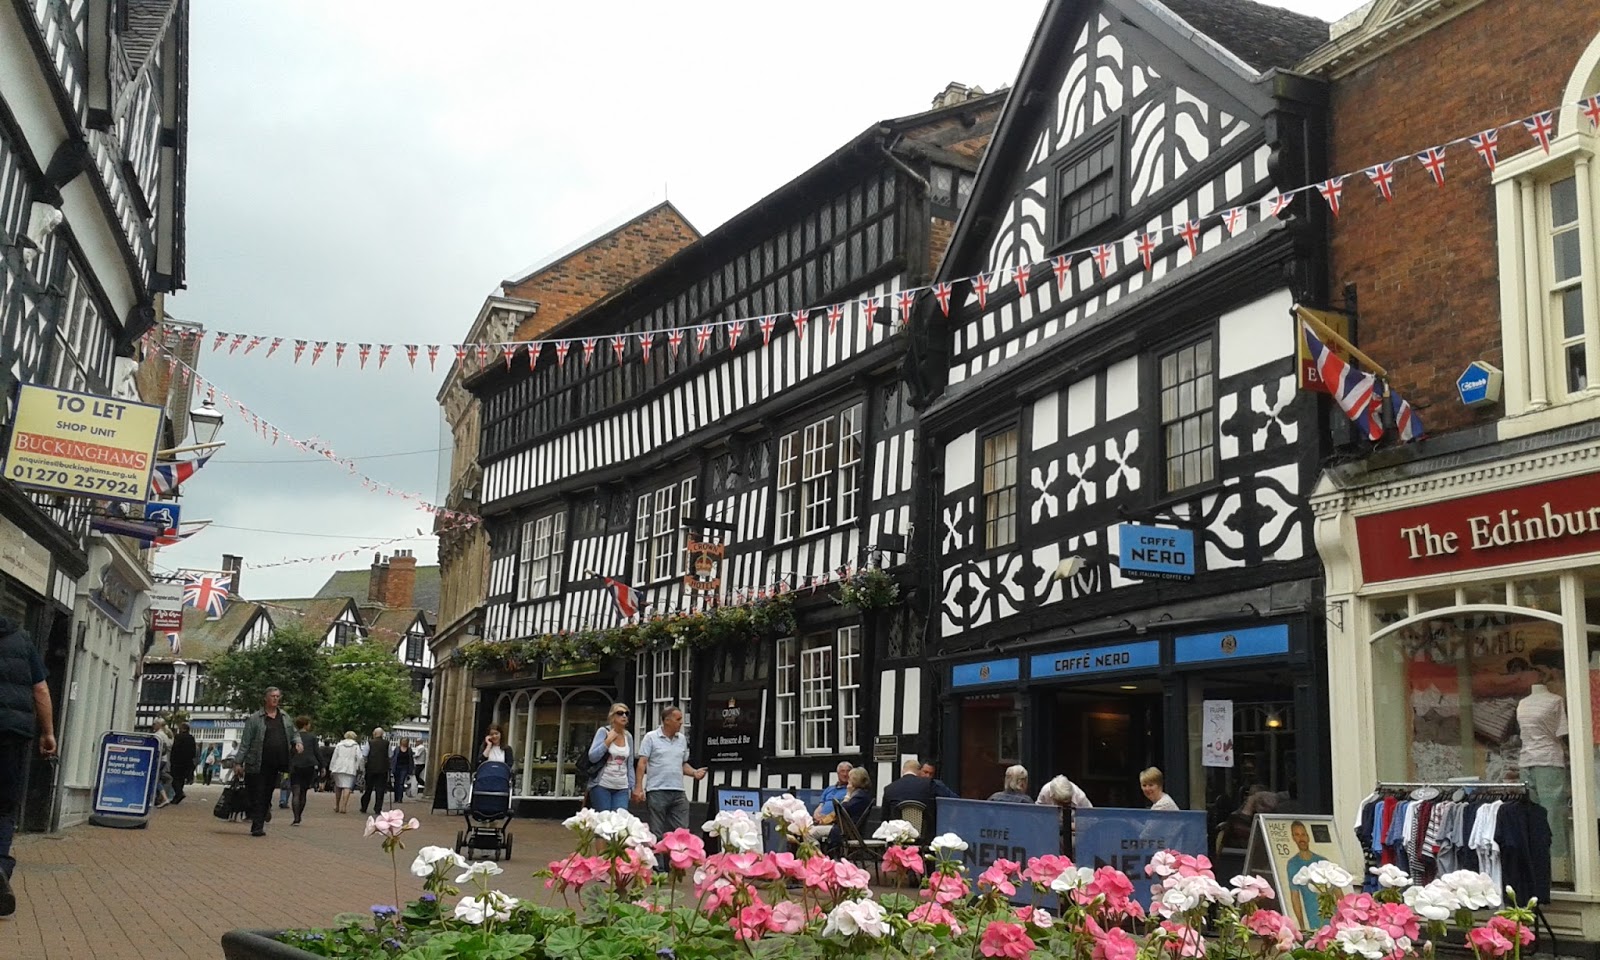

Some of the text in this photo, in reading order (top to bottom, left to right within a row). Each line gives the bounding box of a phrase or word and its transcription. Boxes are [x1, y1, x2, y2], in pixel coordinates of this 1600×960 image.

[56, 394, 126, 421] TO LET
[56, 420, 117, 438] SHOP UNIT
[16, 433, 147, 469] BUCKINGHAMS
[18, 455, 137, 480] enquiries@buckinghams.org.uk
[13, 464, 139, 496] 01270 257924
[693, 542, 719, 553] CROWN
[1400, 522, 1459, 560] The
[1131, 547, 1186, 565] NERO
[691, 579, 715, 589] HOTEL
[150, 594, 180, 602] o-operative
[1095, 652, 1130, 667] NERO
[724, 799, 754, 807] NERO
[1268, 822, 1286, 830] HALF
[1270, 830, 1289, 838] PRICE
[1276, 843, 1290, 856] £6
